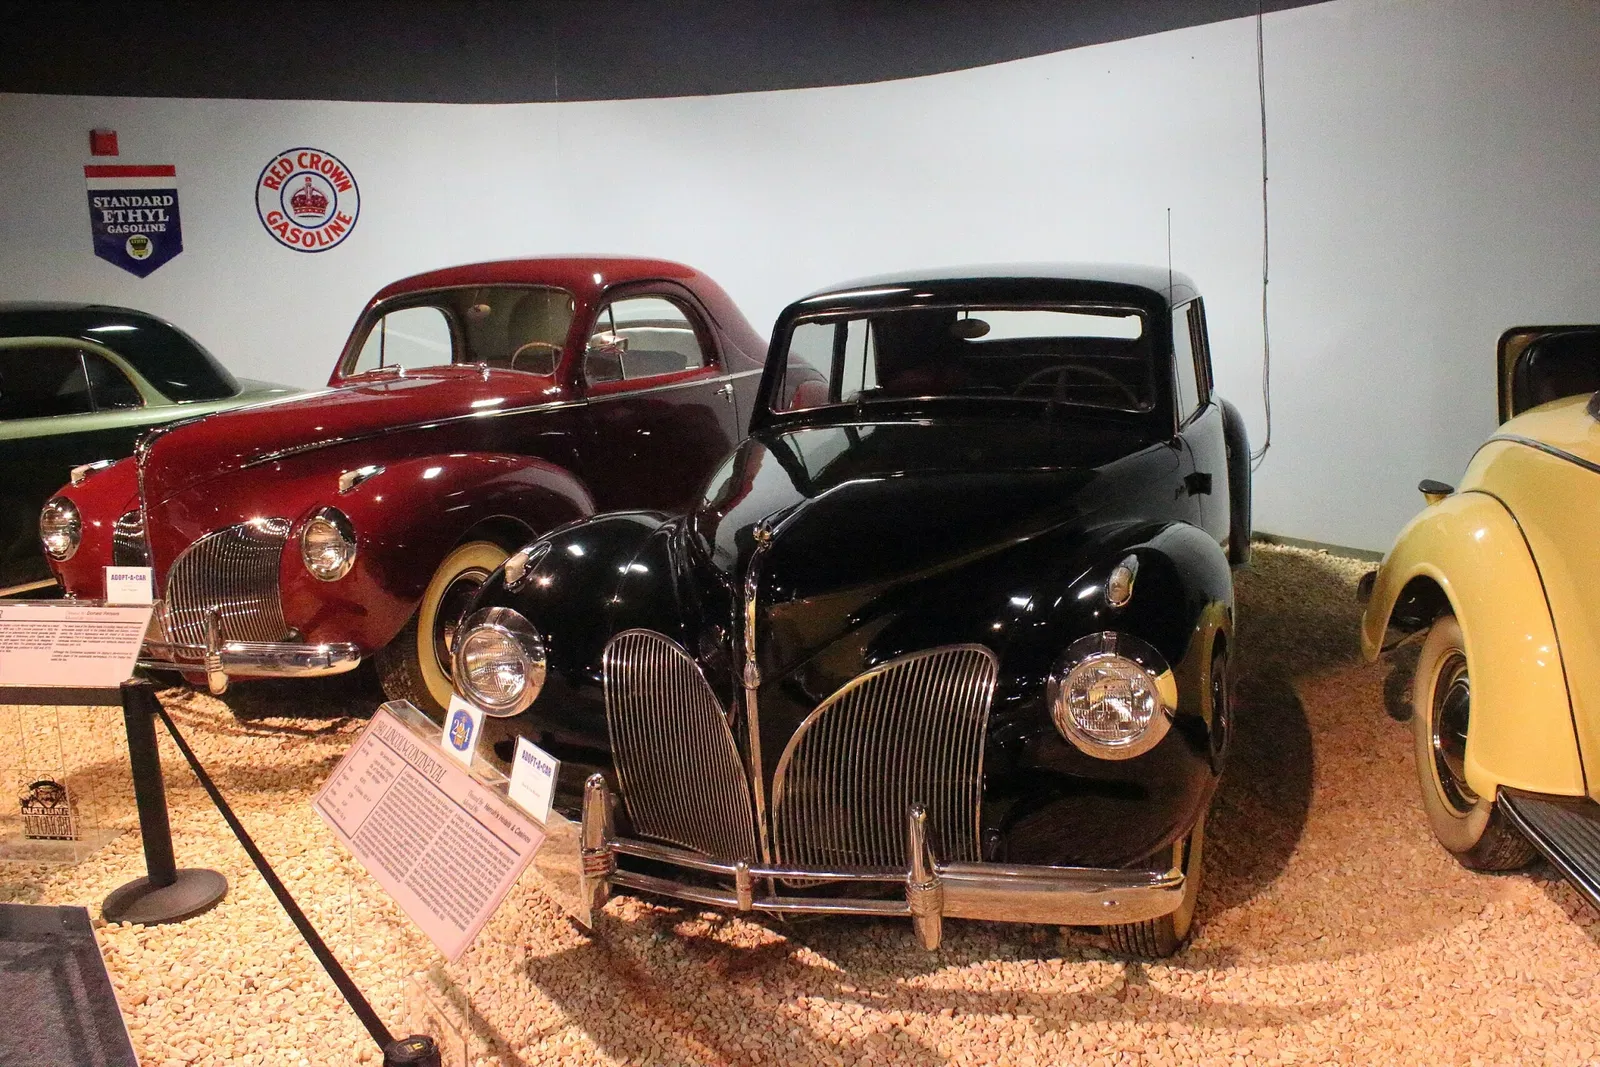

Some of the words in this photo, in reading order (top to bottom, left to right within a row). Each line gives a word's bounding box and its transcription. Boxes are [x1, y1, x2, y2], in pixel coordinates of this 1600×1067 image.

[263, 158, 294, 191] RED
[297, 152, 352, 193] CROWN
[93, 195, 174, 208] STANDARD
[101, 208, 170, 224] ETHYL
[107, 223, 167, 234] GASOLINE
[267, 210, 353, 248] GASOLINE
